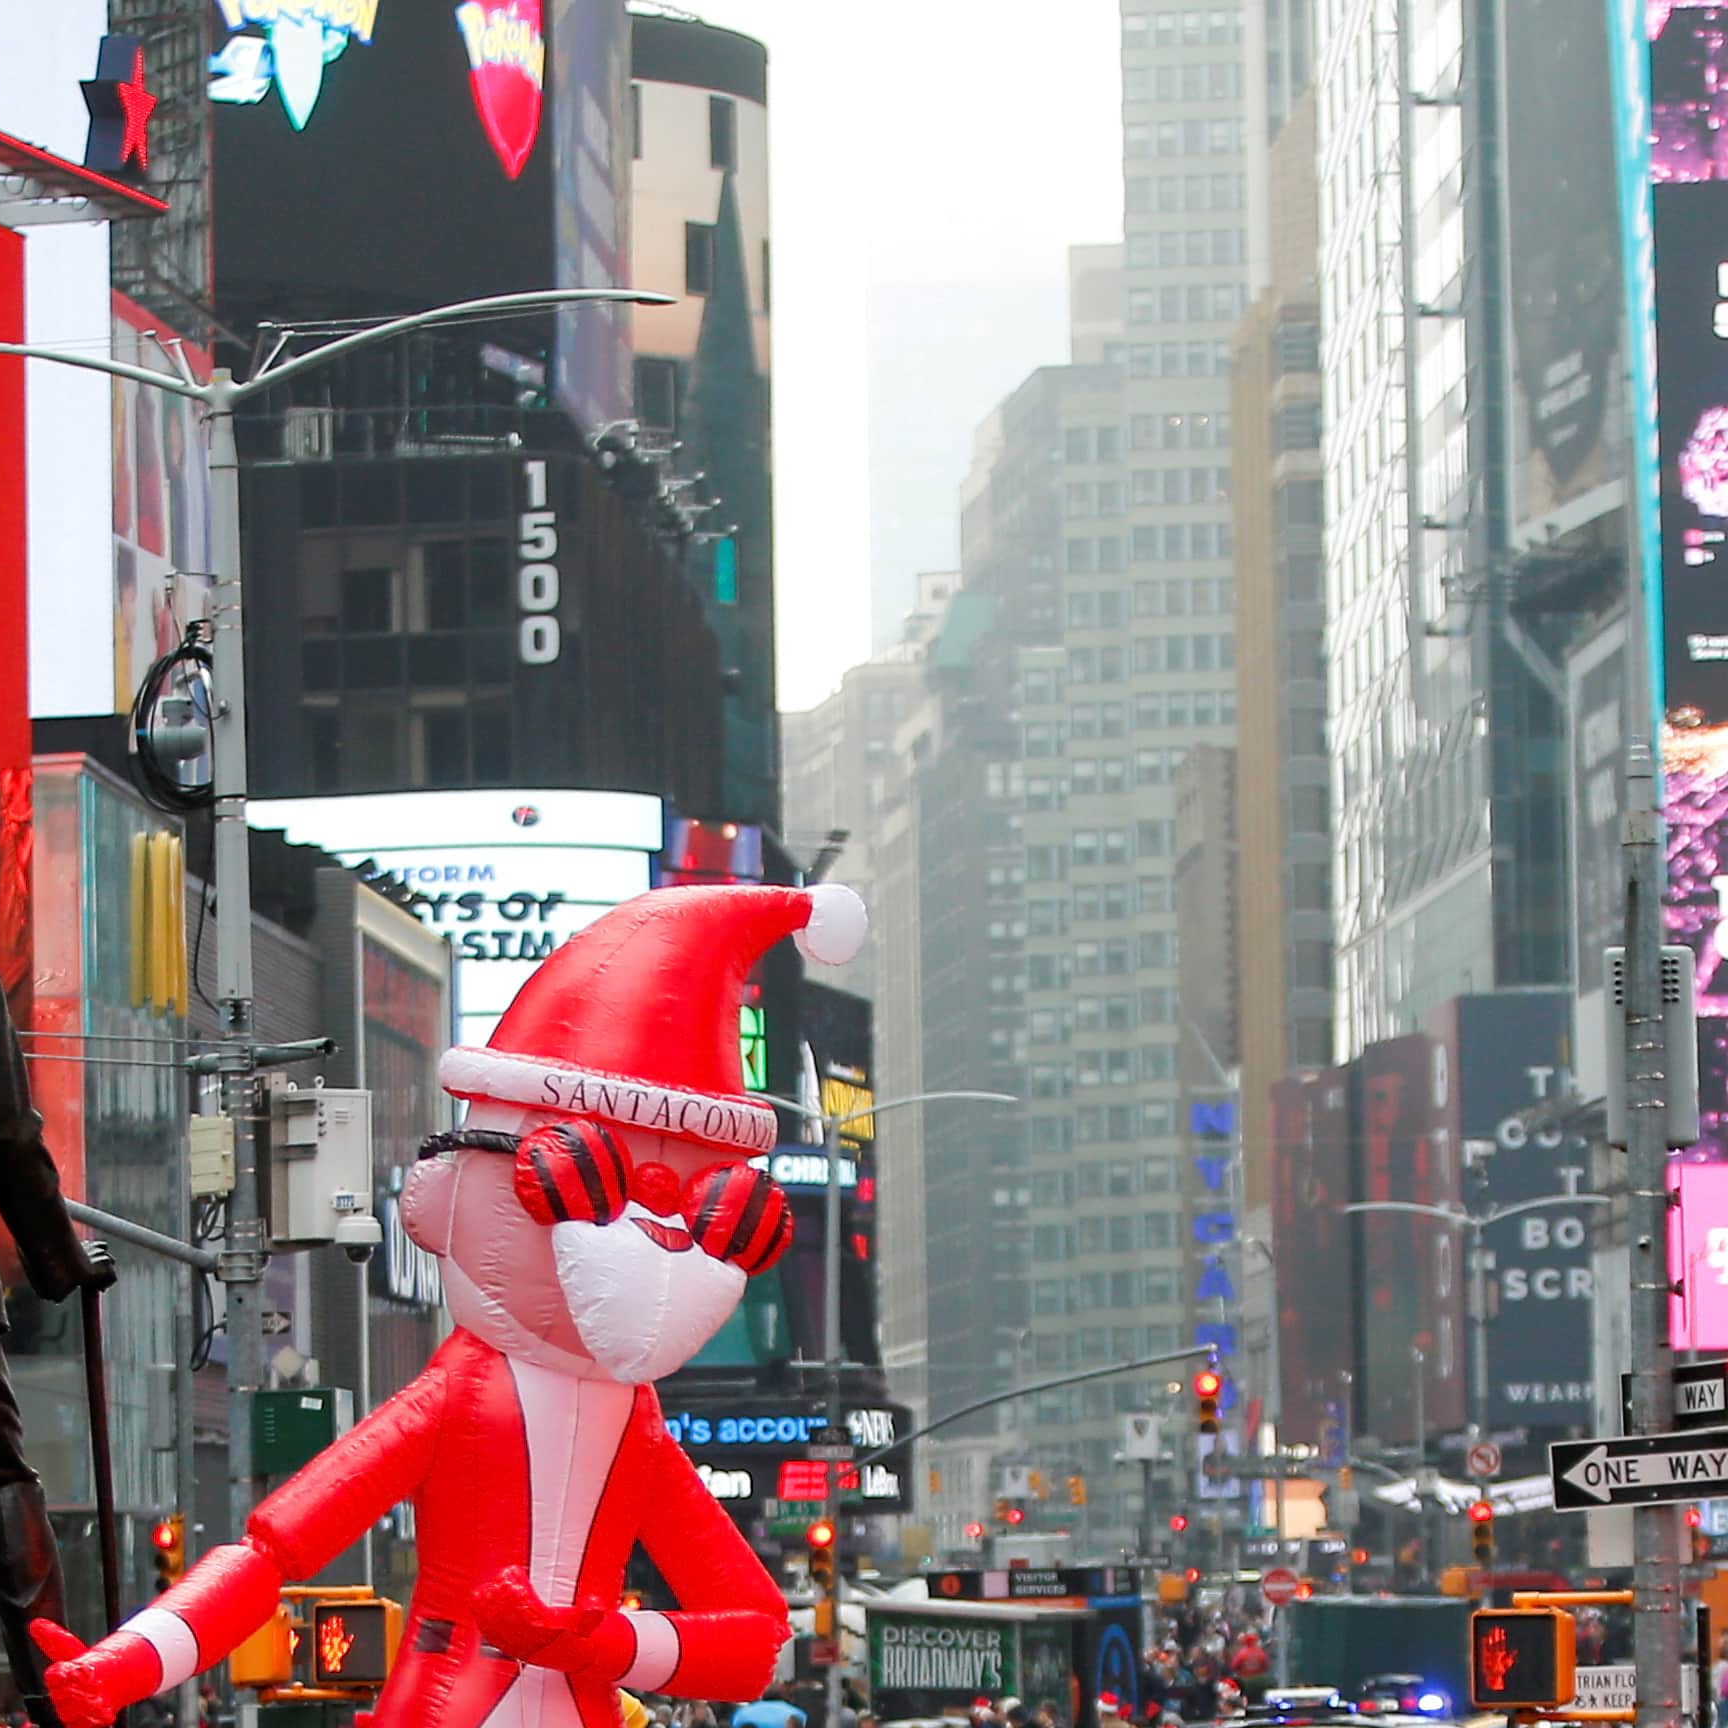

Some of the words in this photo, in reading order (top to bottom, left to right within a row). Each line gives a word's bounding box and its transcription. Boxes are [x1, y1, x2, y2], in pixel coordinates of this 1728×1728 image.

[519, 461, 560, 664] 1500
[497, 891, 566, 922] OF
[1684, 1383, 1719, 1410] WAY
[1584, 1459, 1641, 1487] ONE
[1668, 1452, 1728, 1482] WAY
[883, 1625, 1001, 1649] DISCOVER
[883, 1647, 1003, 1689] BROADWAY'S
[1604, 1694, 1632, 1709] KEEP
